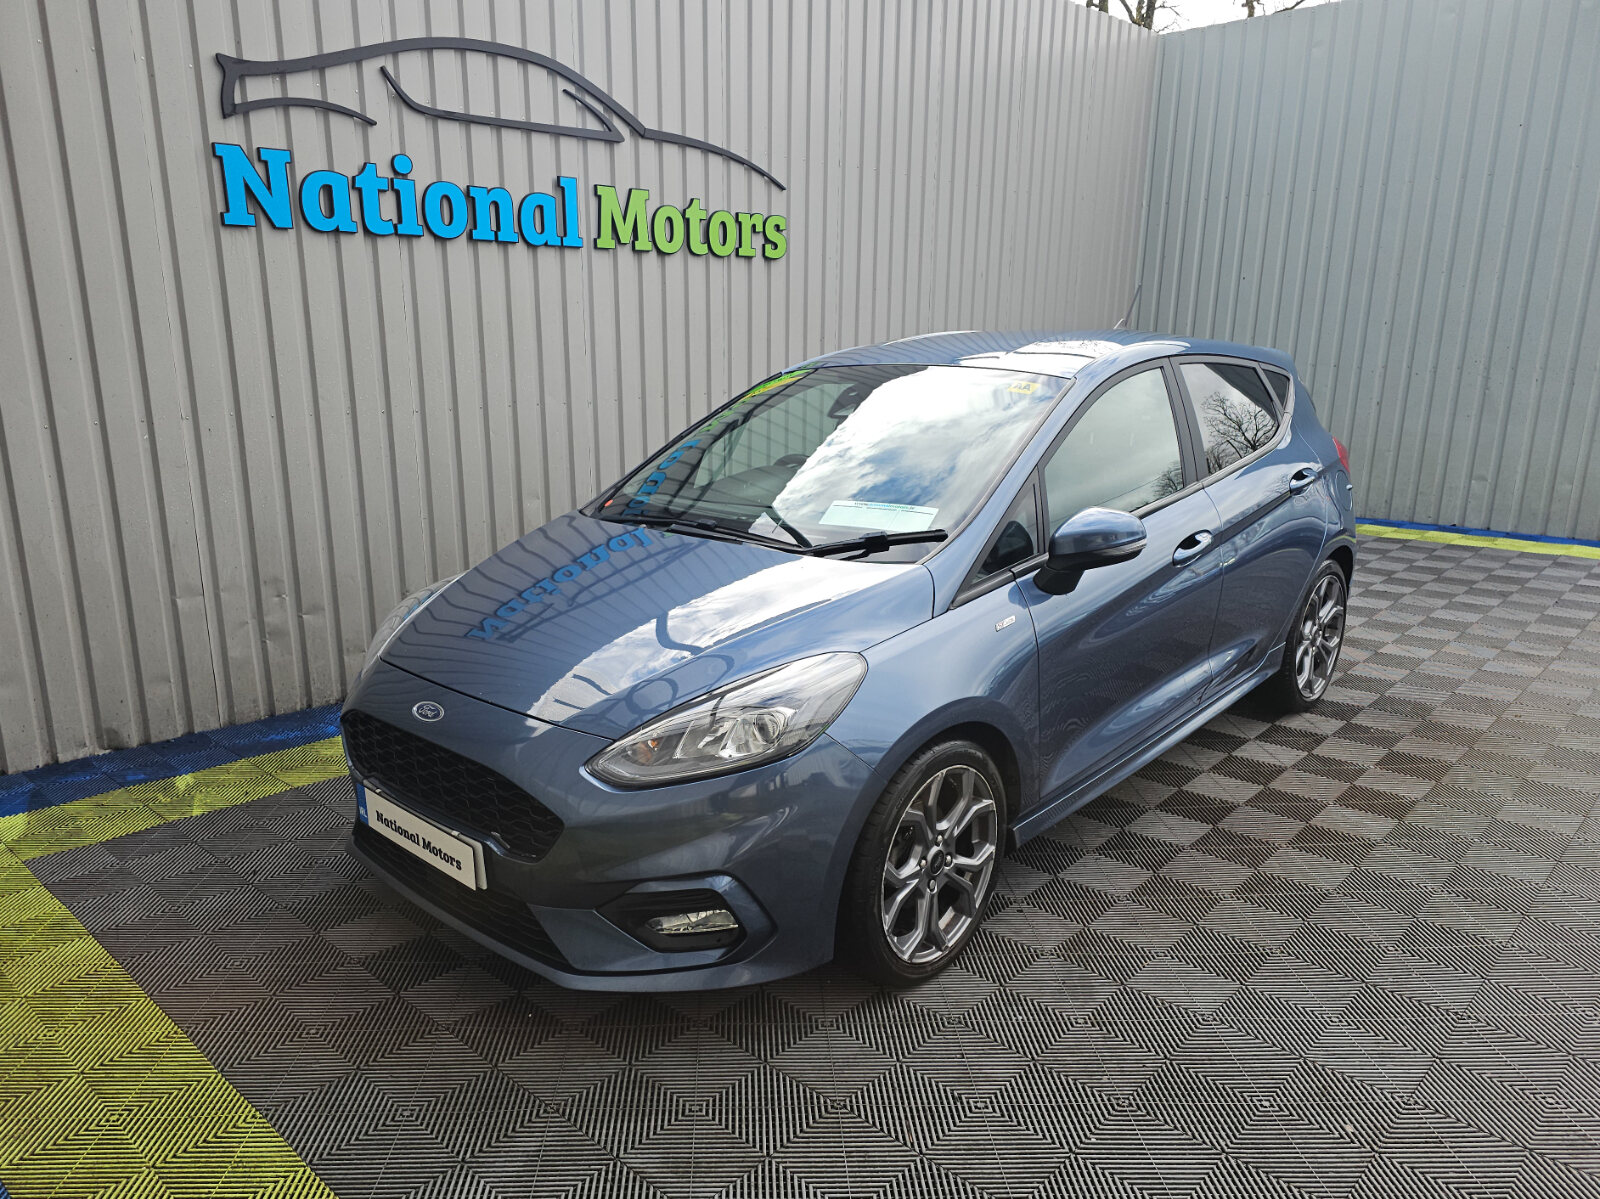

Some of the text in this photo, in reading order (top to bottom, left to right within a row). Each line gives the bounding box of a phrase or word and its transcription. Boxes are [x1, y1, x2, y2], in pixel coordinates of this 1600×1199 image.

[212, 141, 787, 259] National Motors
[375, 810, 462, 871] National Motors
